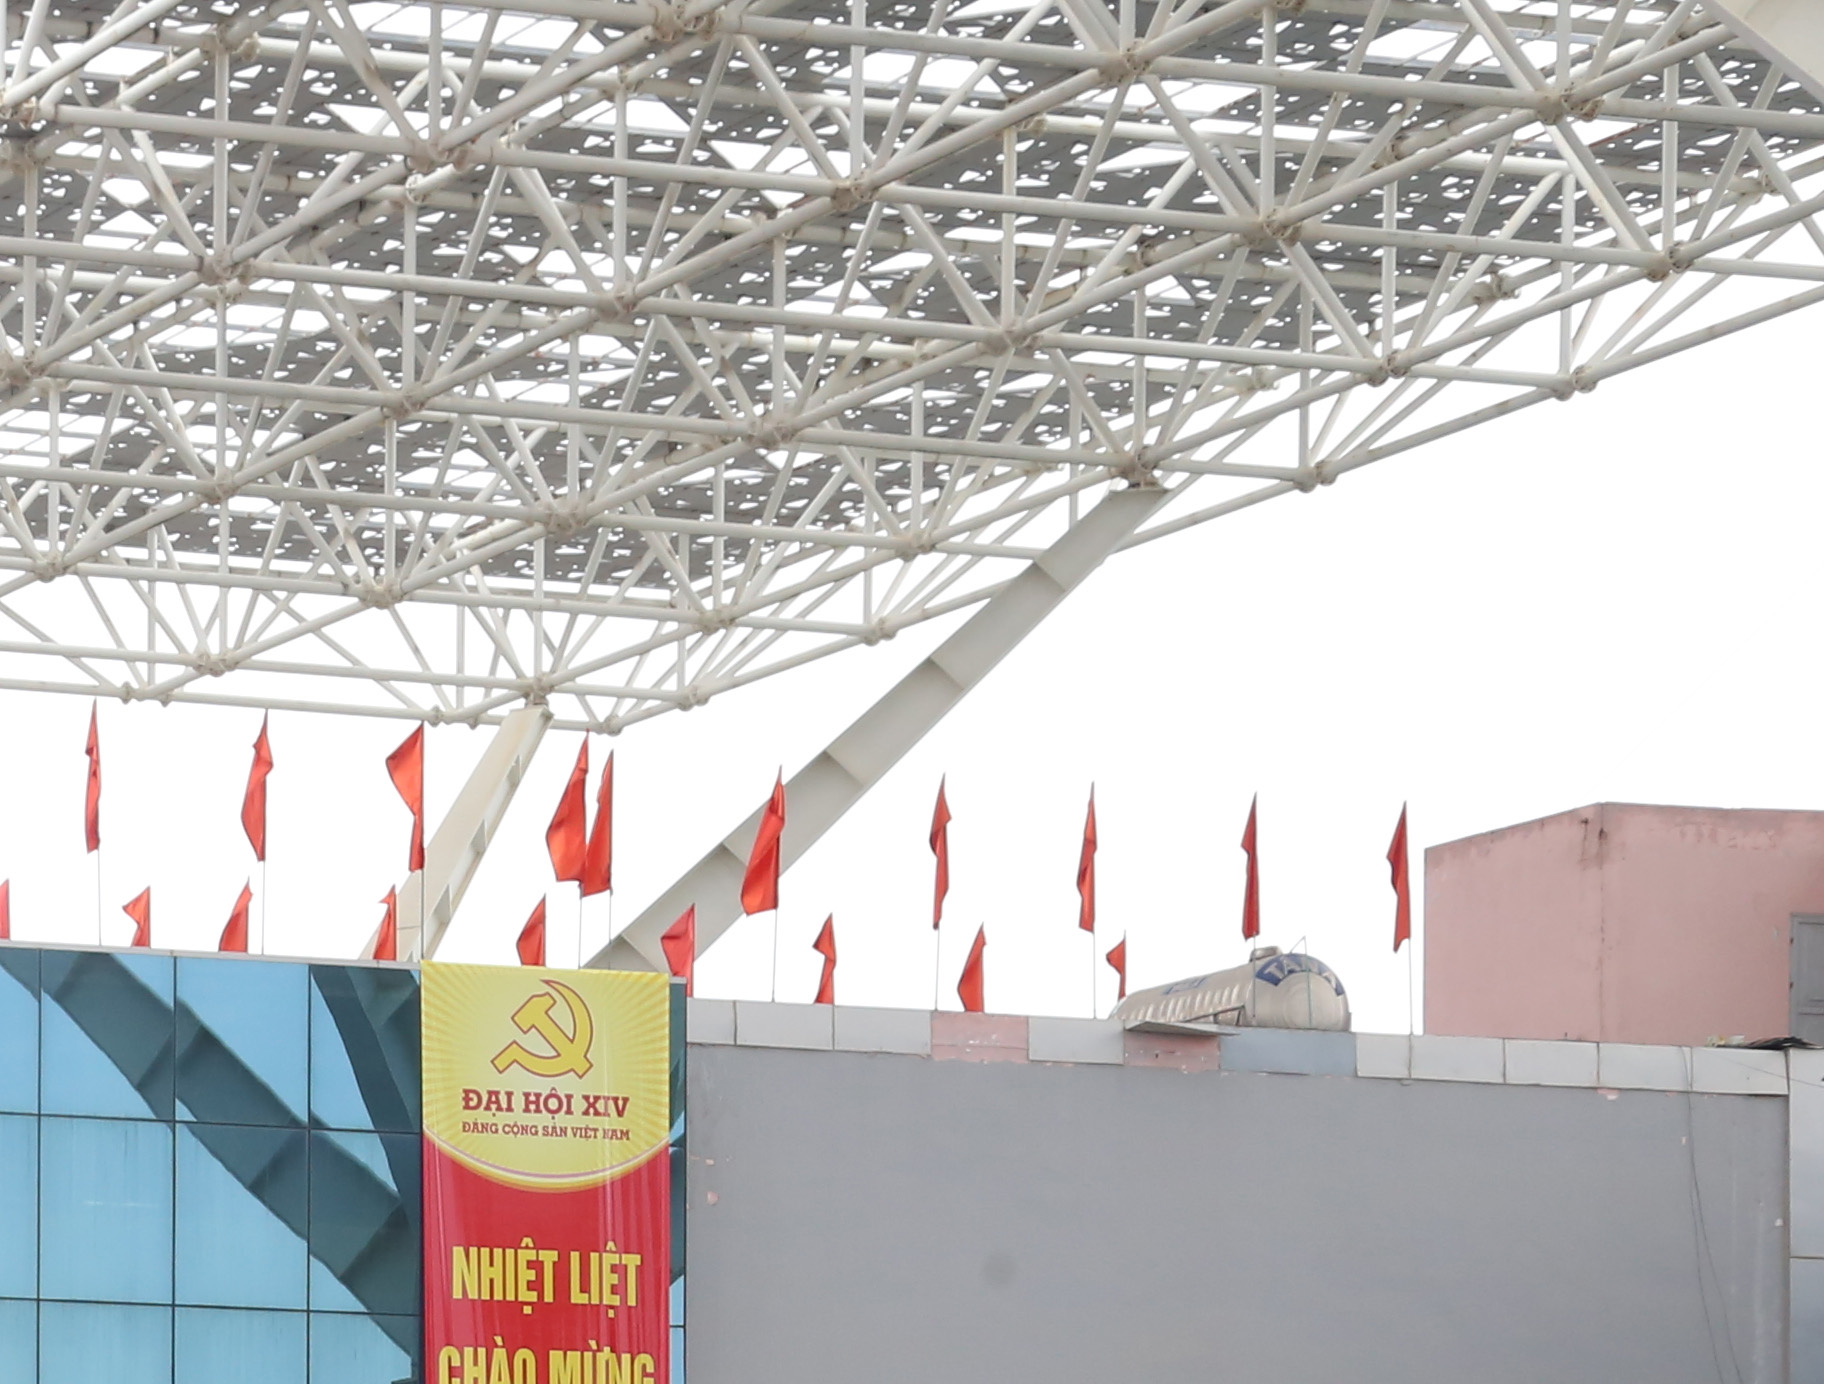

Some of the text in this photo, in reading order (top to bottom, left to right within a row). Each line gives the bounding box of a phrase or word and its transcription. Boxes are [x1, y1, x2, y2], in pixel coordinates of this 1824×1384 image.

[462, 1087, 630, 1120] ĐẠI HỘI XIV
[462, 1118, 499, 1135] ĐẢNG
[502, 1121, 539, 1138] CỘNG
[571, 1124, 599, 1141] VIỆT
[602, 1128, 630, 1141] NAM
[452, 1238, 641, 1318] NHIỆT LIỆT
